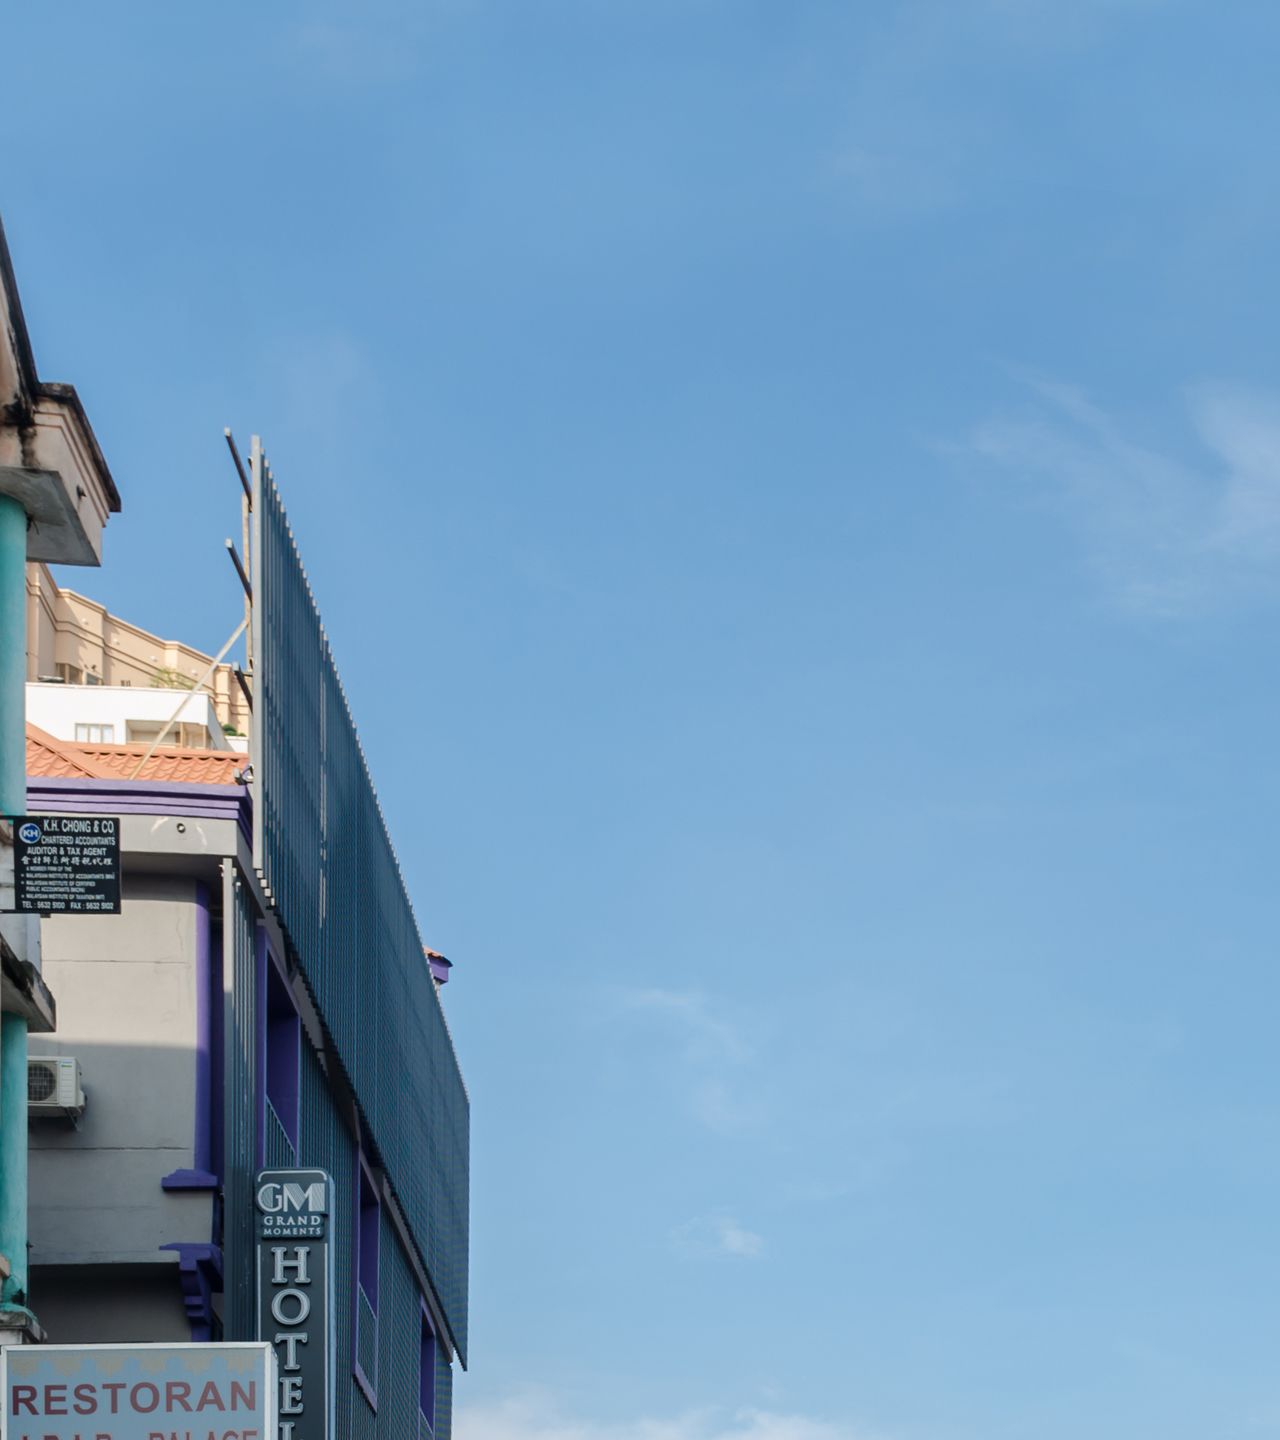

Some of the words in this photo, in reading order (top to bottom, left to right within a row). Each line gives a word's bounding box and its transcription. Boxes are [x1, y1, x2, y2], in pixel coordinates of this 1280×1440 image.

[43, 819, 59, 831] K.H.
[61, 820, 91, 833] CHONG
[93, 821, 100, 833] &
[23, 829, 38, 837] KH
[41, 836, 73, 845] CHARTERED
[75, 836, 116, 846] ACCOUNTANTS
[27, 847, 58, 855] AUDITOR
[67, 847, 81, 855] TAX
[83, 848, 107, 856] AGENT
[22, 901, 33, 909] TEL
[258, 1183, 326, 1212] GM
[264, 1215, 321, 1226] GRAND
[264, 1227, 321, 1236] MOMENTS
[12, 1380, 257, 1416] RESTORAN
